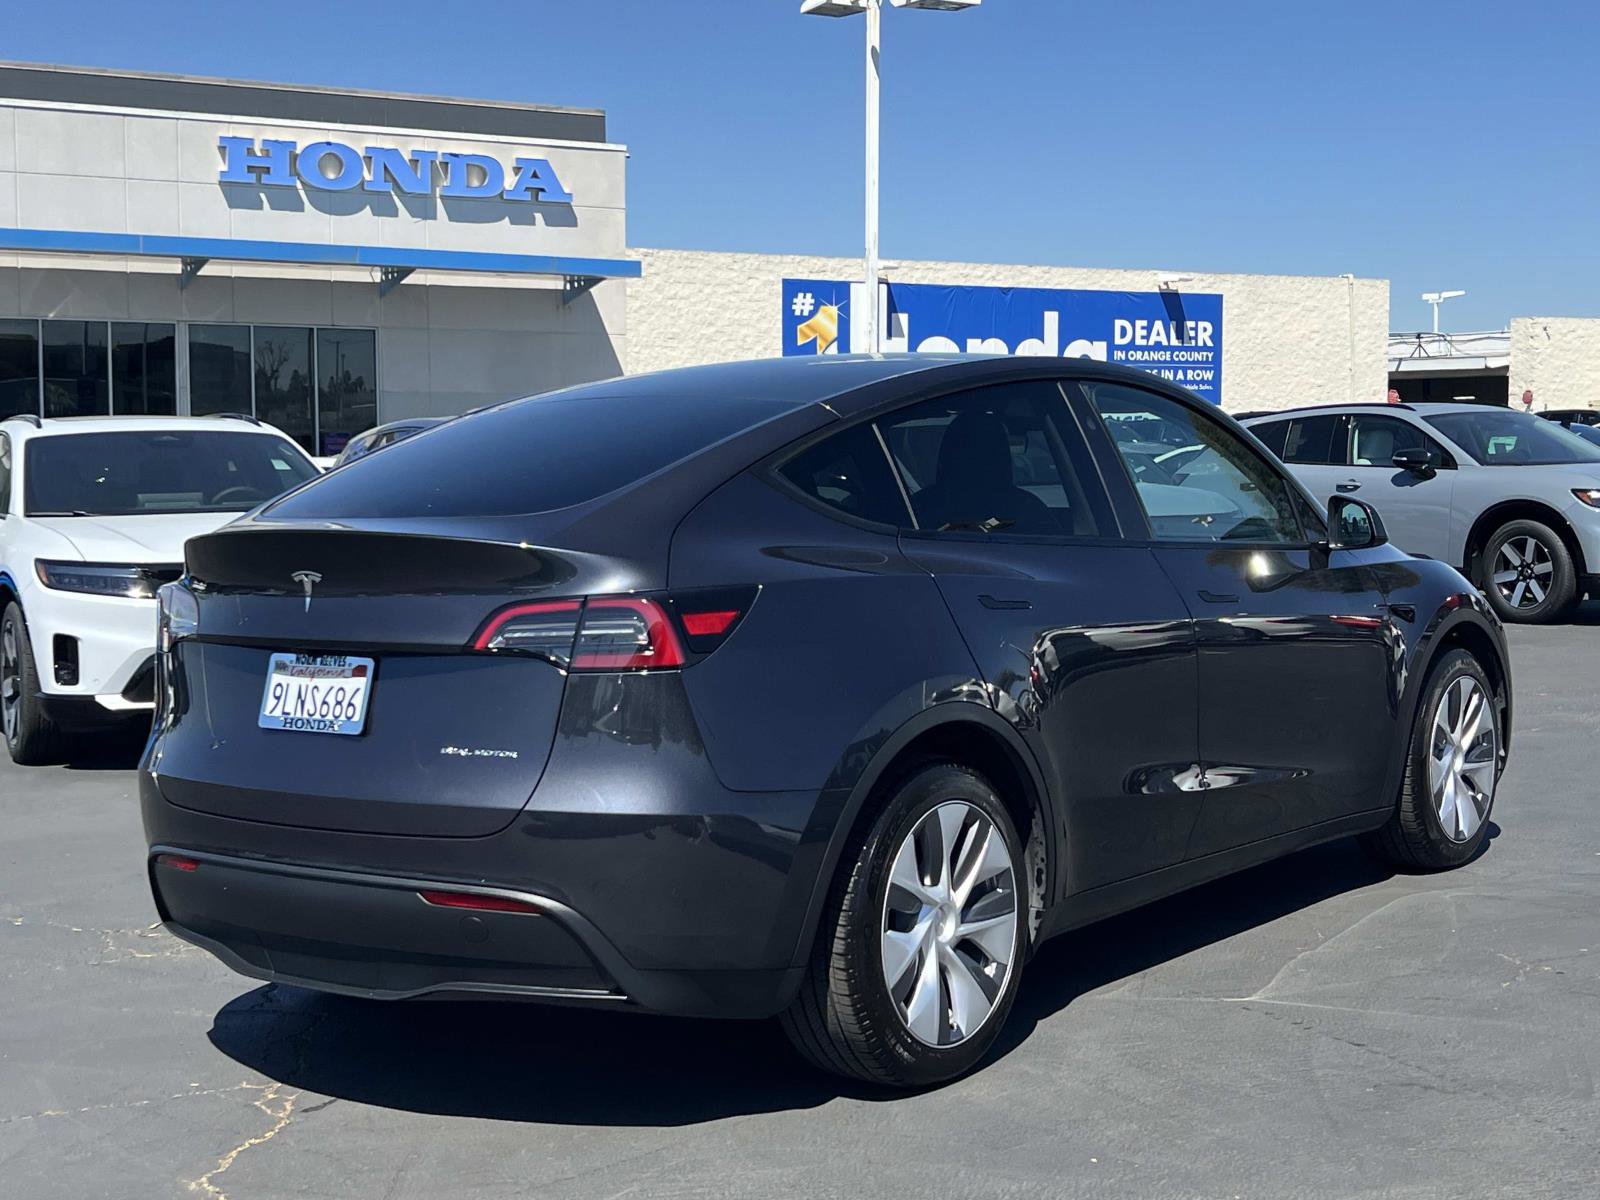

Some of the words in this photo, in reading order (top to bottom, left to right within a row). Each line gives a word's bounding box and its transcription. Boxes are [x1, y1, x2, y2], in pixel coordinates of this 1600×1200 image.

[219, 136, 573, 203] HONDA
[1114, 319, 1214, 347] DEALER
[1114, 350, 1126, 361] IN
[1128, 350, 1171, 361] ORANGE
[1173, 351, 1214, 362] COUNTY
[1161, 369, 1174, 381] IN
[1176, 369, 1185, 381] A
[1187, 369, 1214, 381] ROW
[289, 666, 345, 681] California
[269, 682, 361, 720] 9LNS686
[283, 718, 341, 731] HONDA
